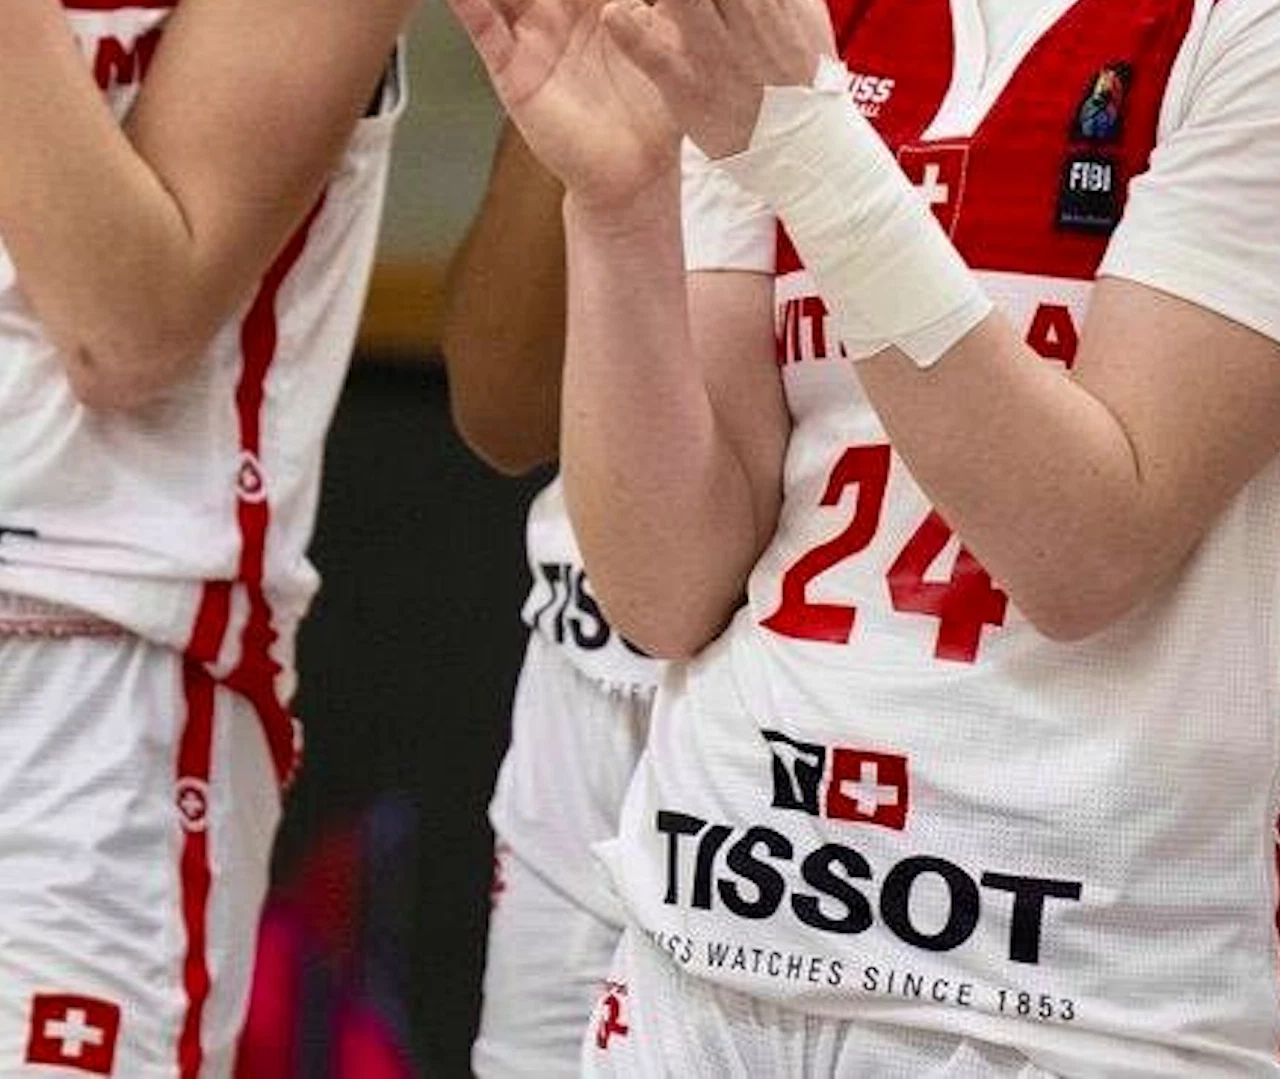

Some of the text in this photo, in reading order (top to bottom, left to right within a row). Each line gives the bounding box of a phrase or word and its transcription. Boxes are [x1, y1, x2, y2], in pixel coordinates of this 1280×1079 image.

[758, 443, 1008, 664] 24
[657, 810, 1082, 965] TISSOT
[706, 941, 843, 986] WATCHES
[863, 966, 972, 1007] SINCE
[997, 990, 1076, 1021] 1853
